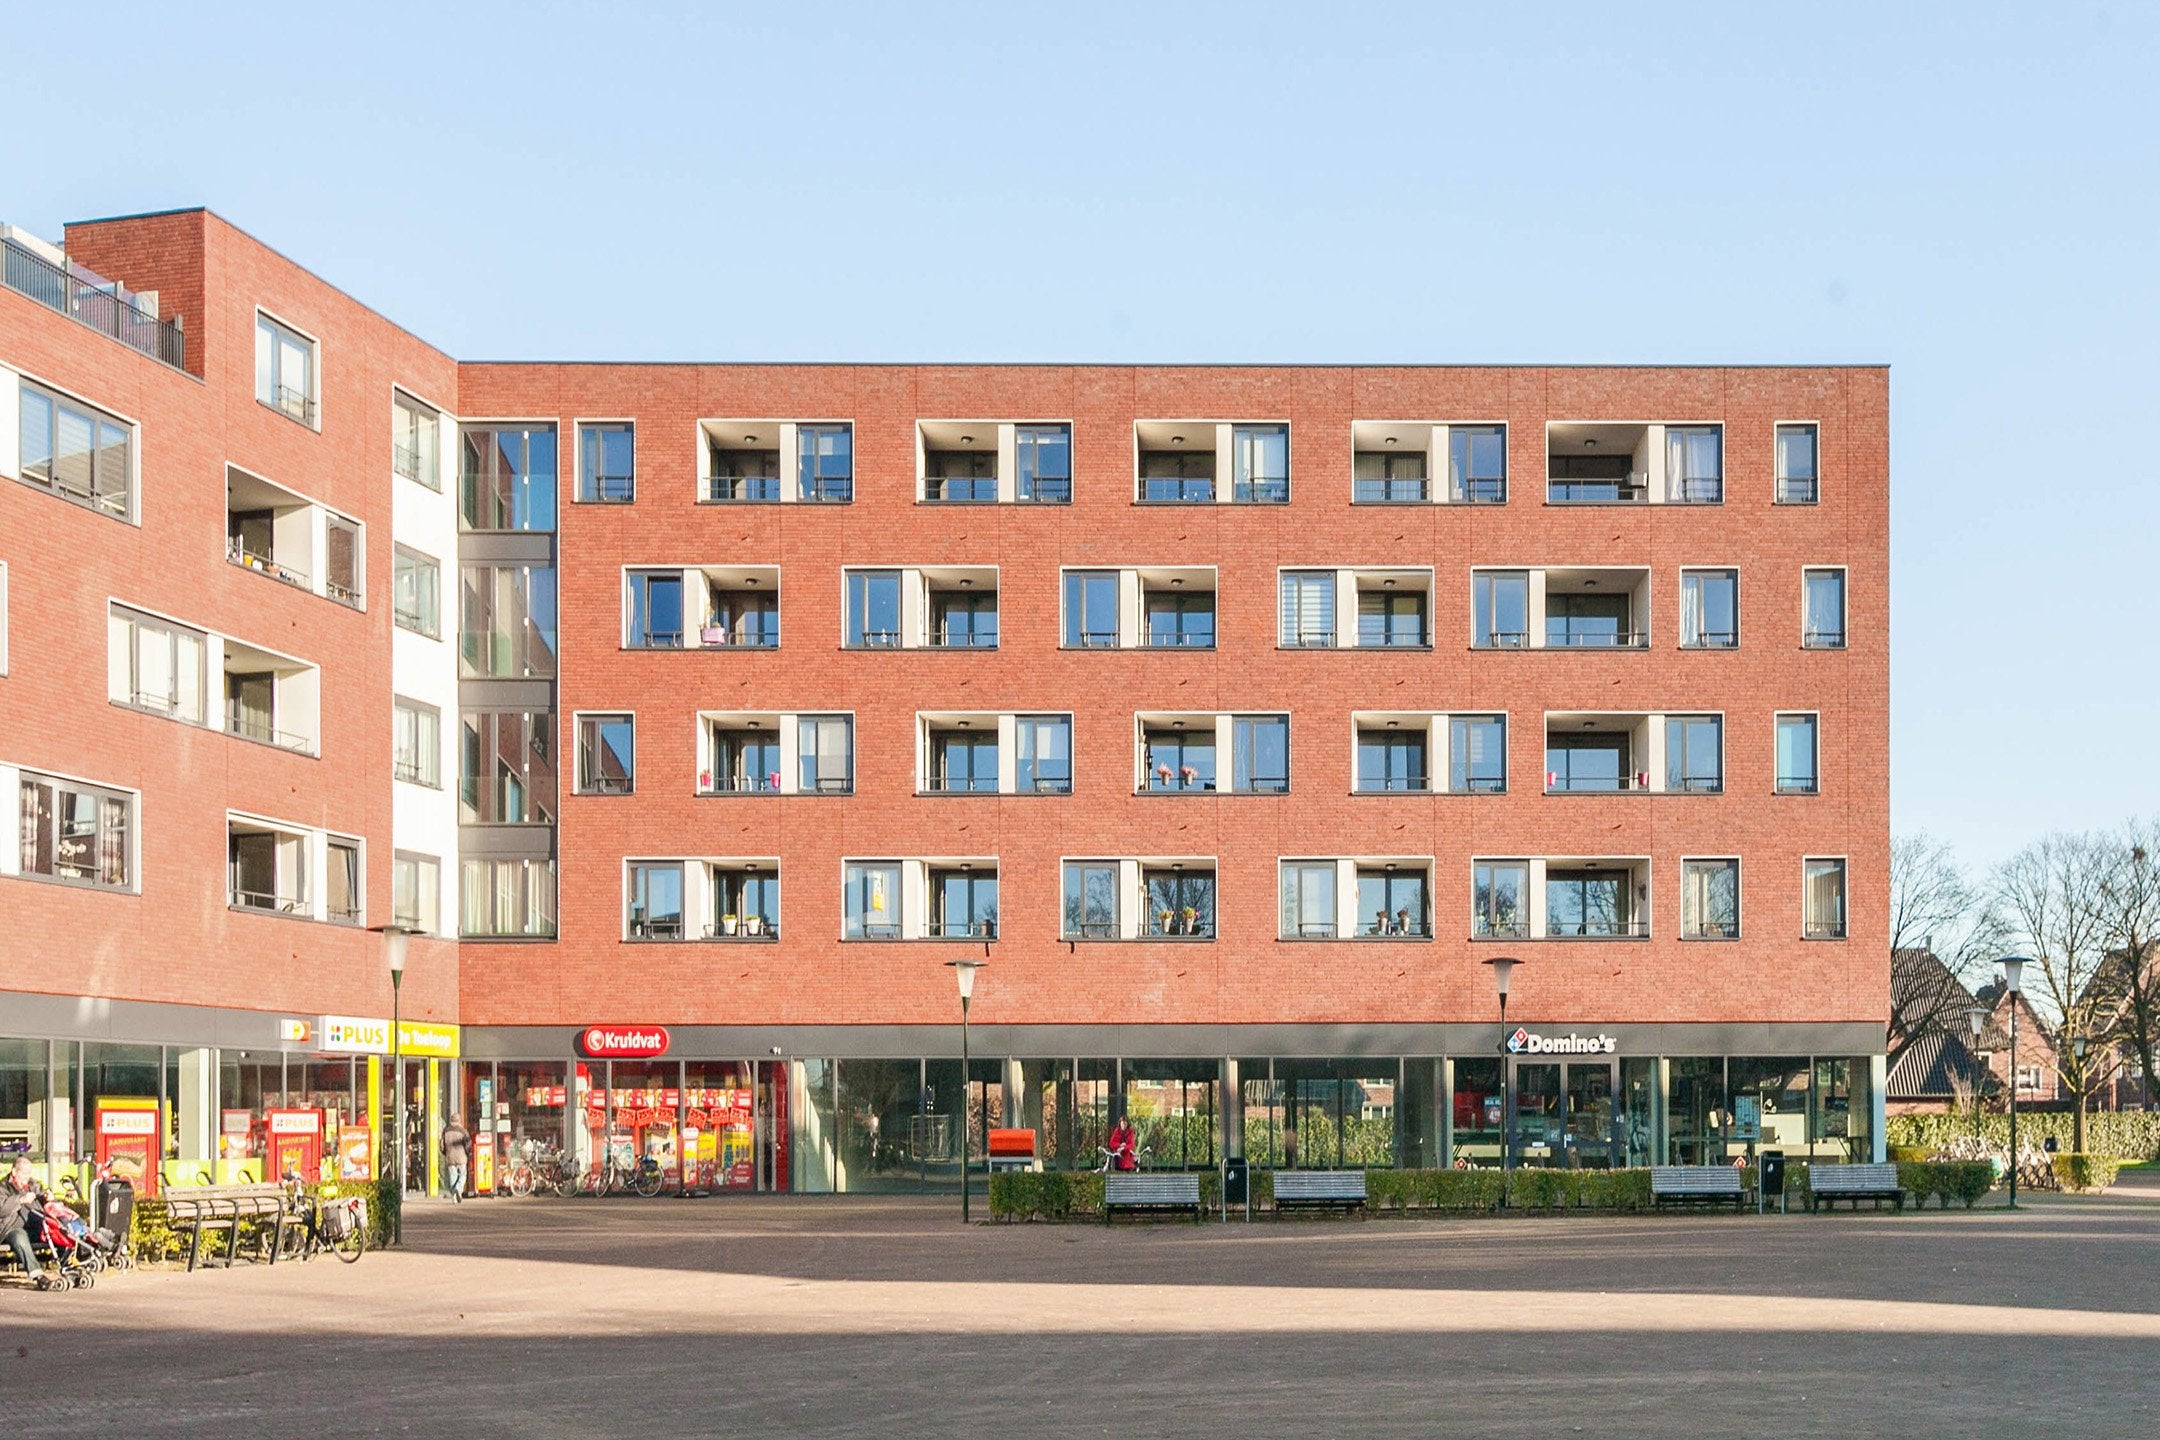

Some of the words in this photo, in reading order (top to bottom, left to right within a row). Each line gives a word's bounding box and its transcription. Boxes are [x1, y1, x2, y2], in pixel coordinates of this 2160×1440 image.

[343, 1026, 384, 1044] PLUS
[412, 1029, 452, 1050] Toeloop
[605, 1031, 661, 1049] Kruidvat
[1527, 1032, 1616, 1053] Domino's
[116, 1118, 150, 1127] PLUS
[285, 1118, 314, 1128] PLUS
